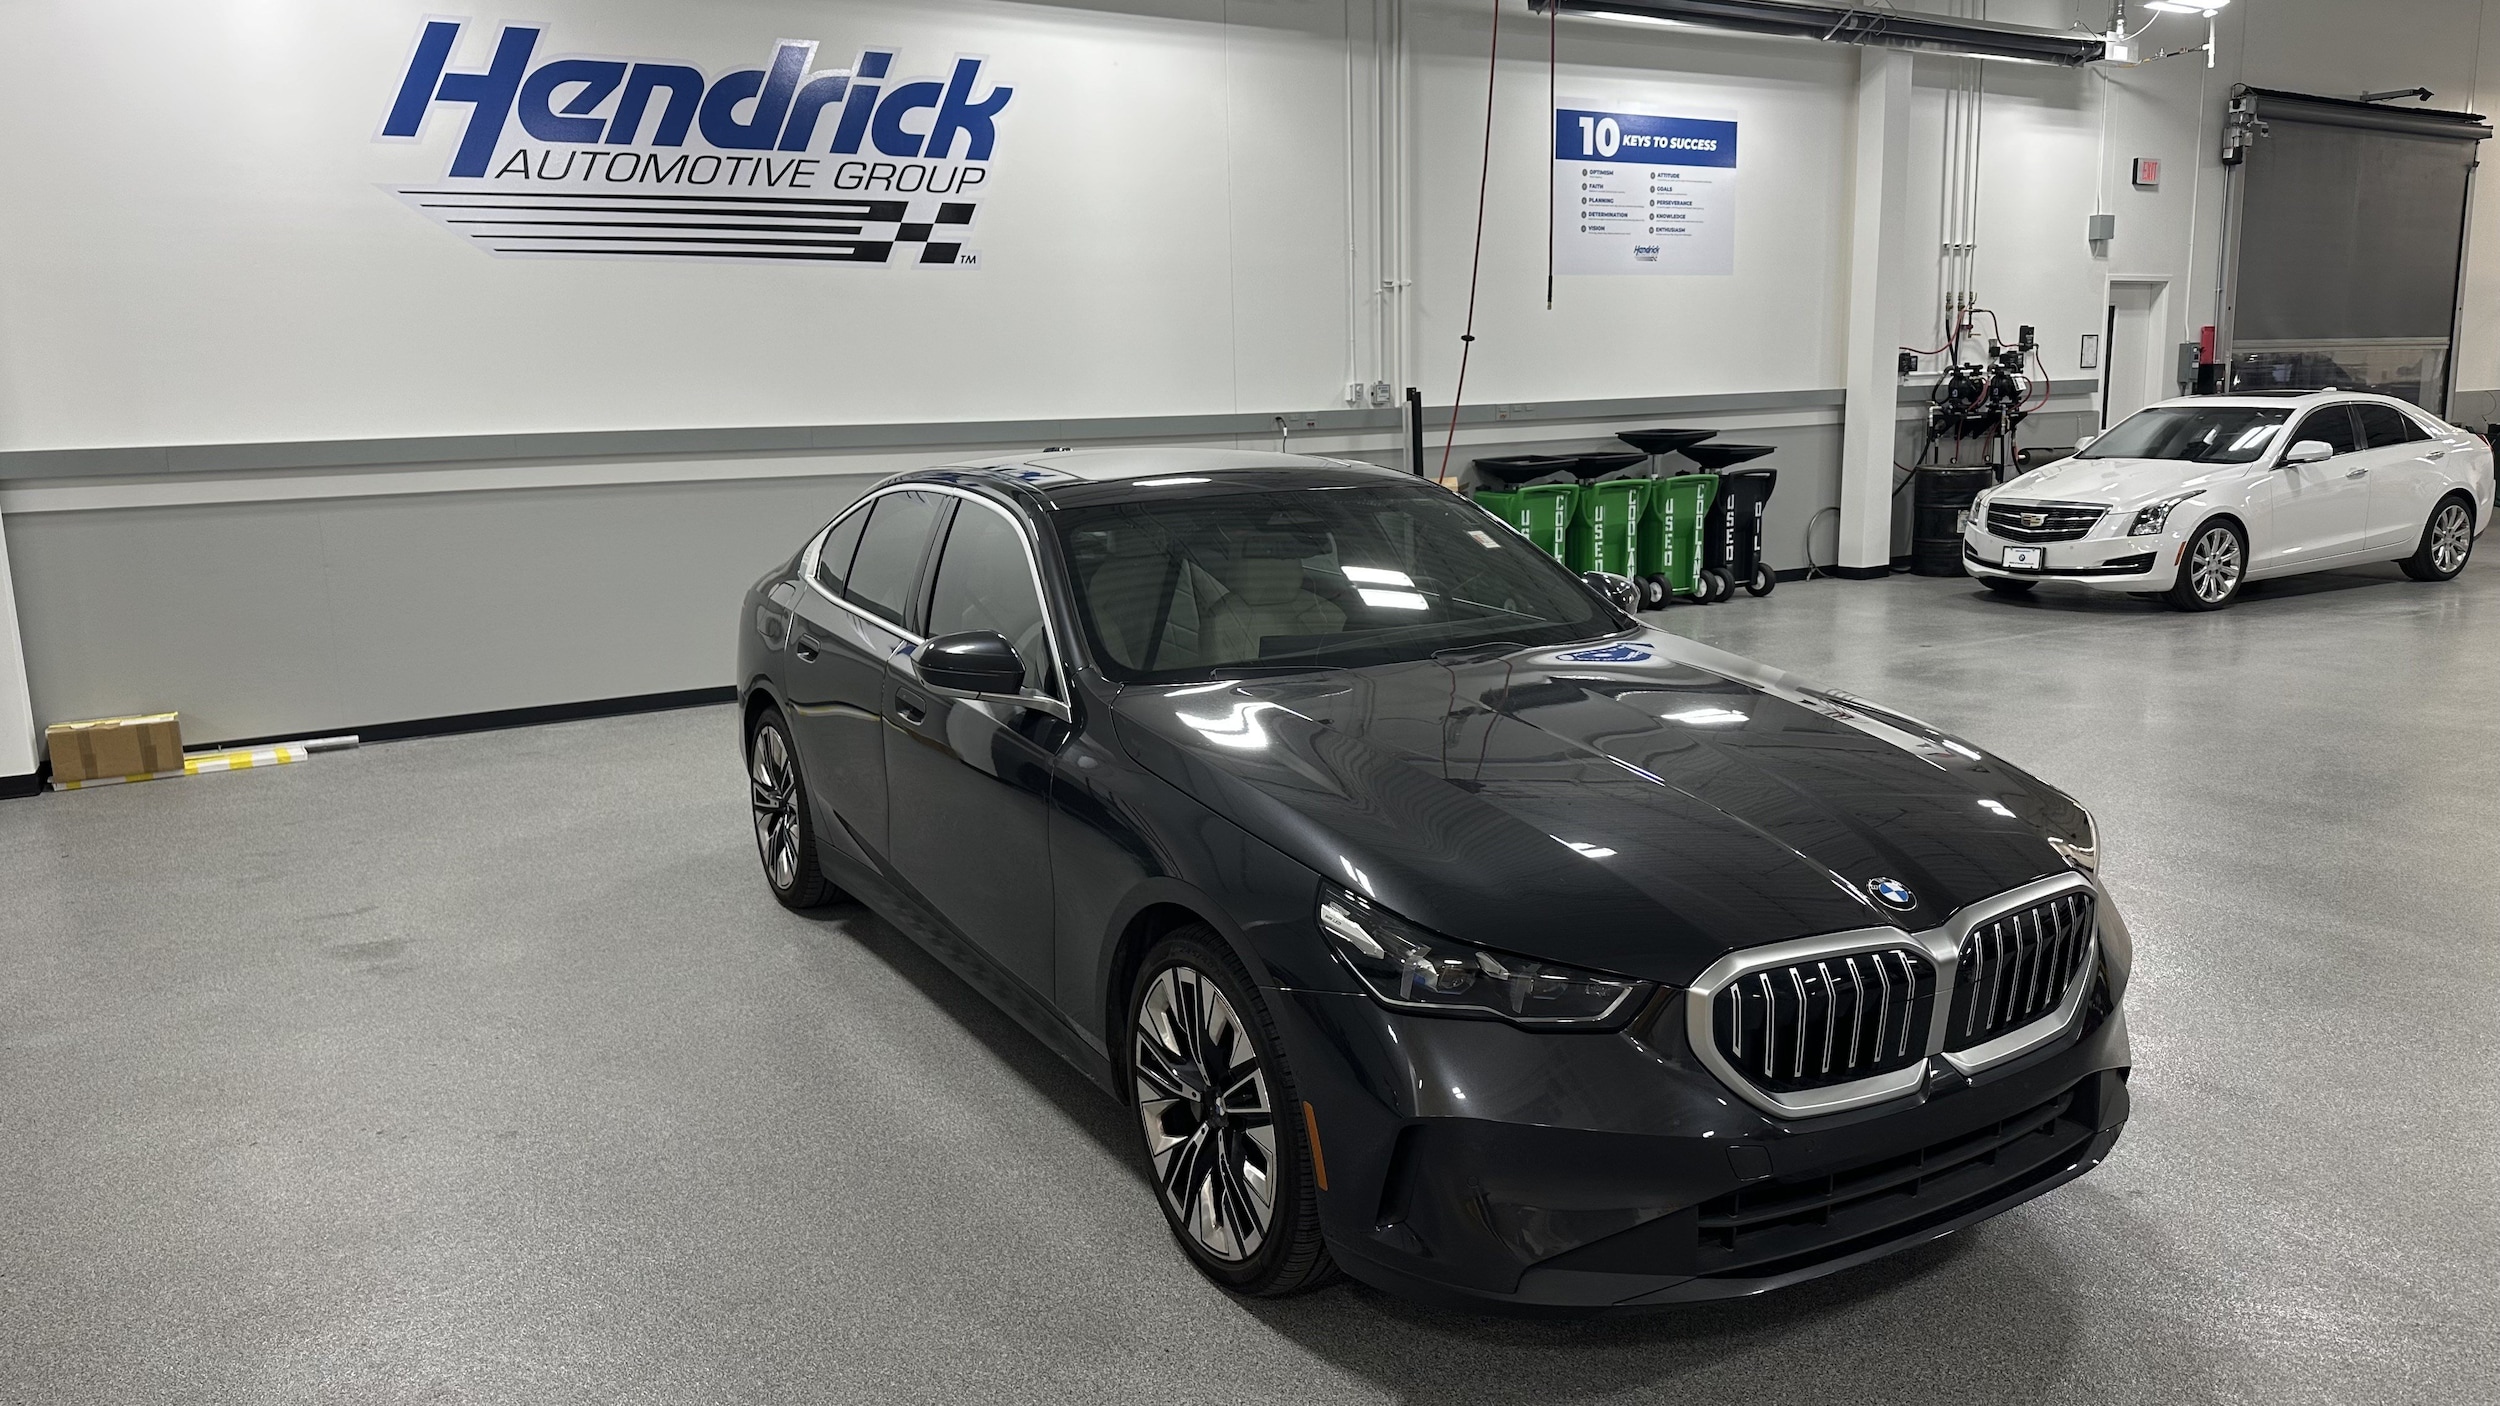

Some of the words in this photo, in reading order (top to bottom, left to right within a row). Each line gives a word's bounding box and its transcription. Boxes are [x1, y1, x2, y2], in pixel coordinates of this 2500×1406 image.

[380, 19, 1014, 179] Hendrick
[1578, 116, 1620, 158] 10
[1622, 134, 1651, 148] KEYS
[1653, 136, 1668, 149] TO
[1669, 137, 1718, 152] SUCCESS
[494, 147, 820, 189] AUTOMOTIVE
[833, 161, 986, 195] GROUP
[2142, 161, 2158, 182] EXIT
[960, 255, 977, 265] TM
[1633, 245, 1661, 256] Hendrick
[1627, 489, 1637, 583] COOLAN
[1664, 498, 1674, 567] USED
[1692, 483, 1705, 590] COOLANT
[1725, 494, 1735, 561] USED
[1753, 501, 1762, 552] OIL
